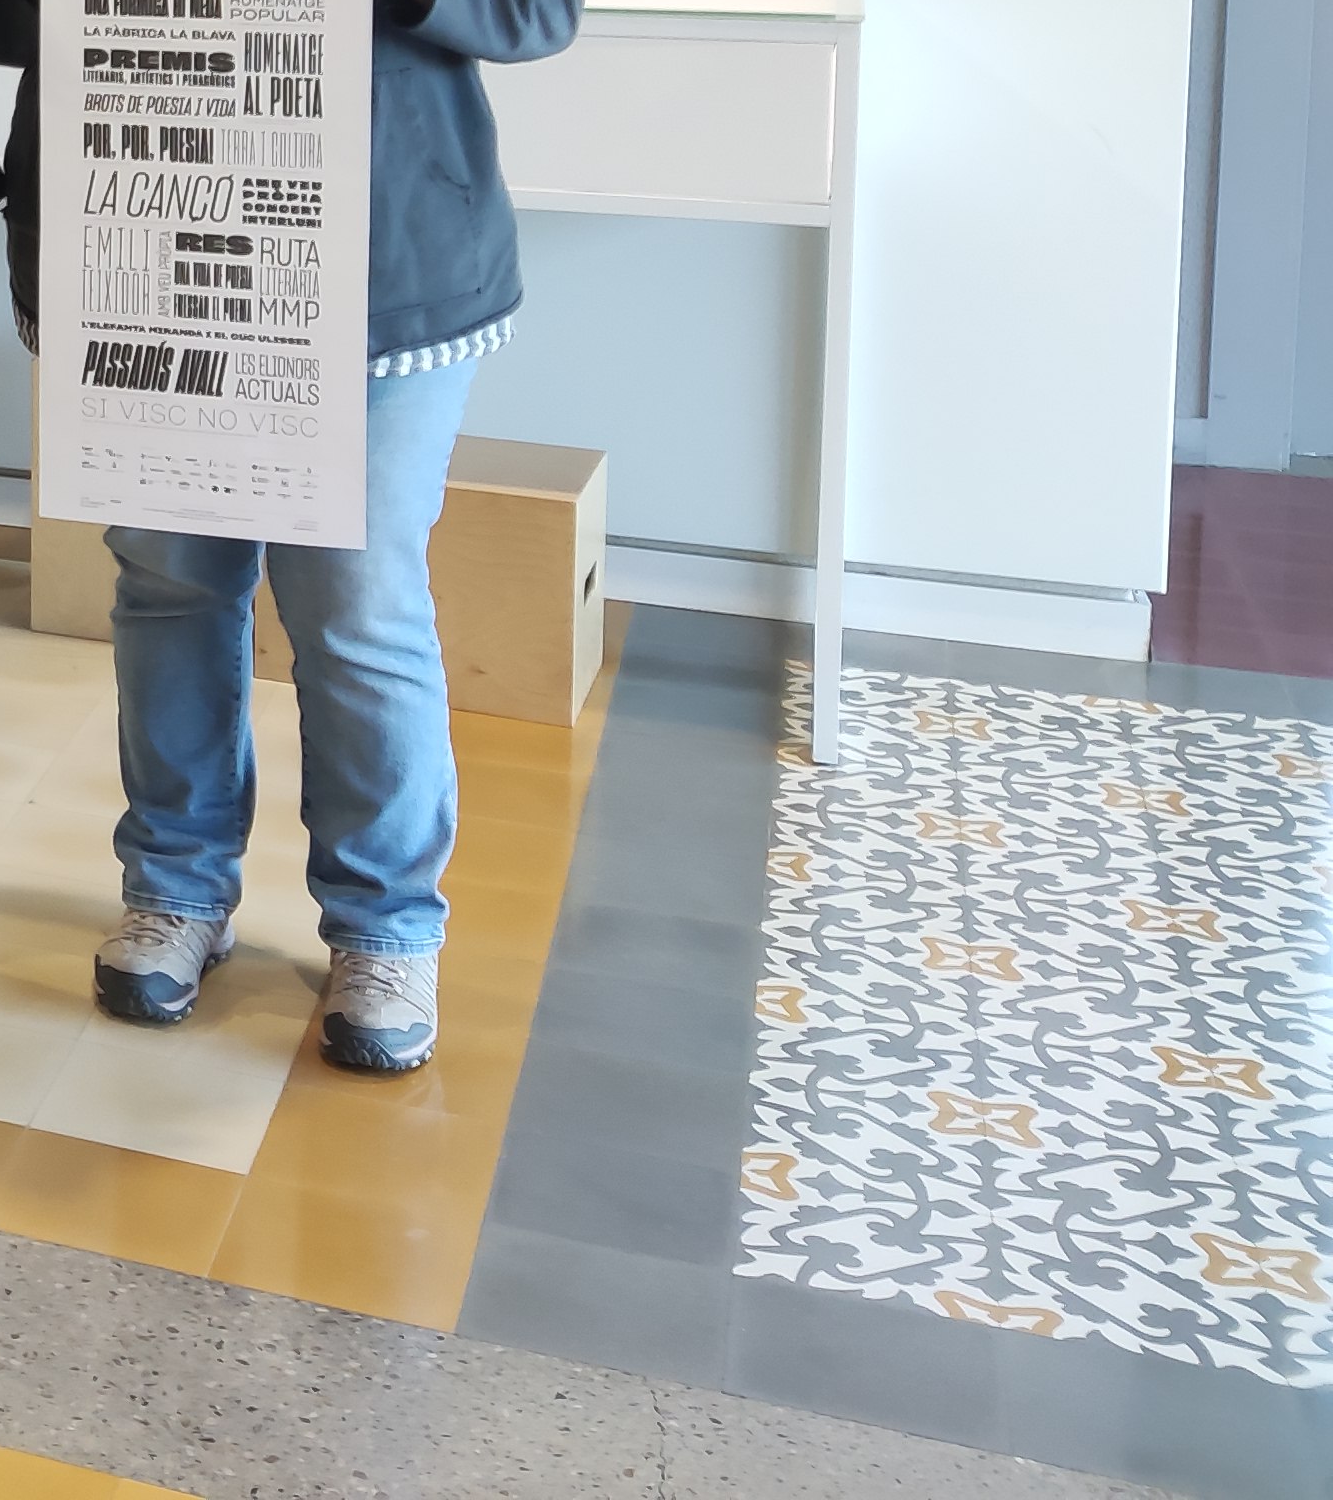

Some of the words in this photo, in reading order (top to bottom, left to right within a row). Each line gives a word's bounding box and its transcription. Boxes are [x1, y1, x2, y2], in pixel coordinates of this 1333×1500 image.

[230, 7, 324, 22] POPULAR
[83, 48, 235, 74] PREMIS
[244, 76, 263, 115] AL
[270, 77, 322, 119] POETA
[84, 169, 118, 216] LA
[127, 172, 234, 223] CANÇÓ
[260, 237, 320, 269] RUTA
[259, 296, 319, 328] MMP
[235, 377, 319, 406] ACTUALS
